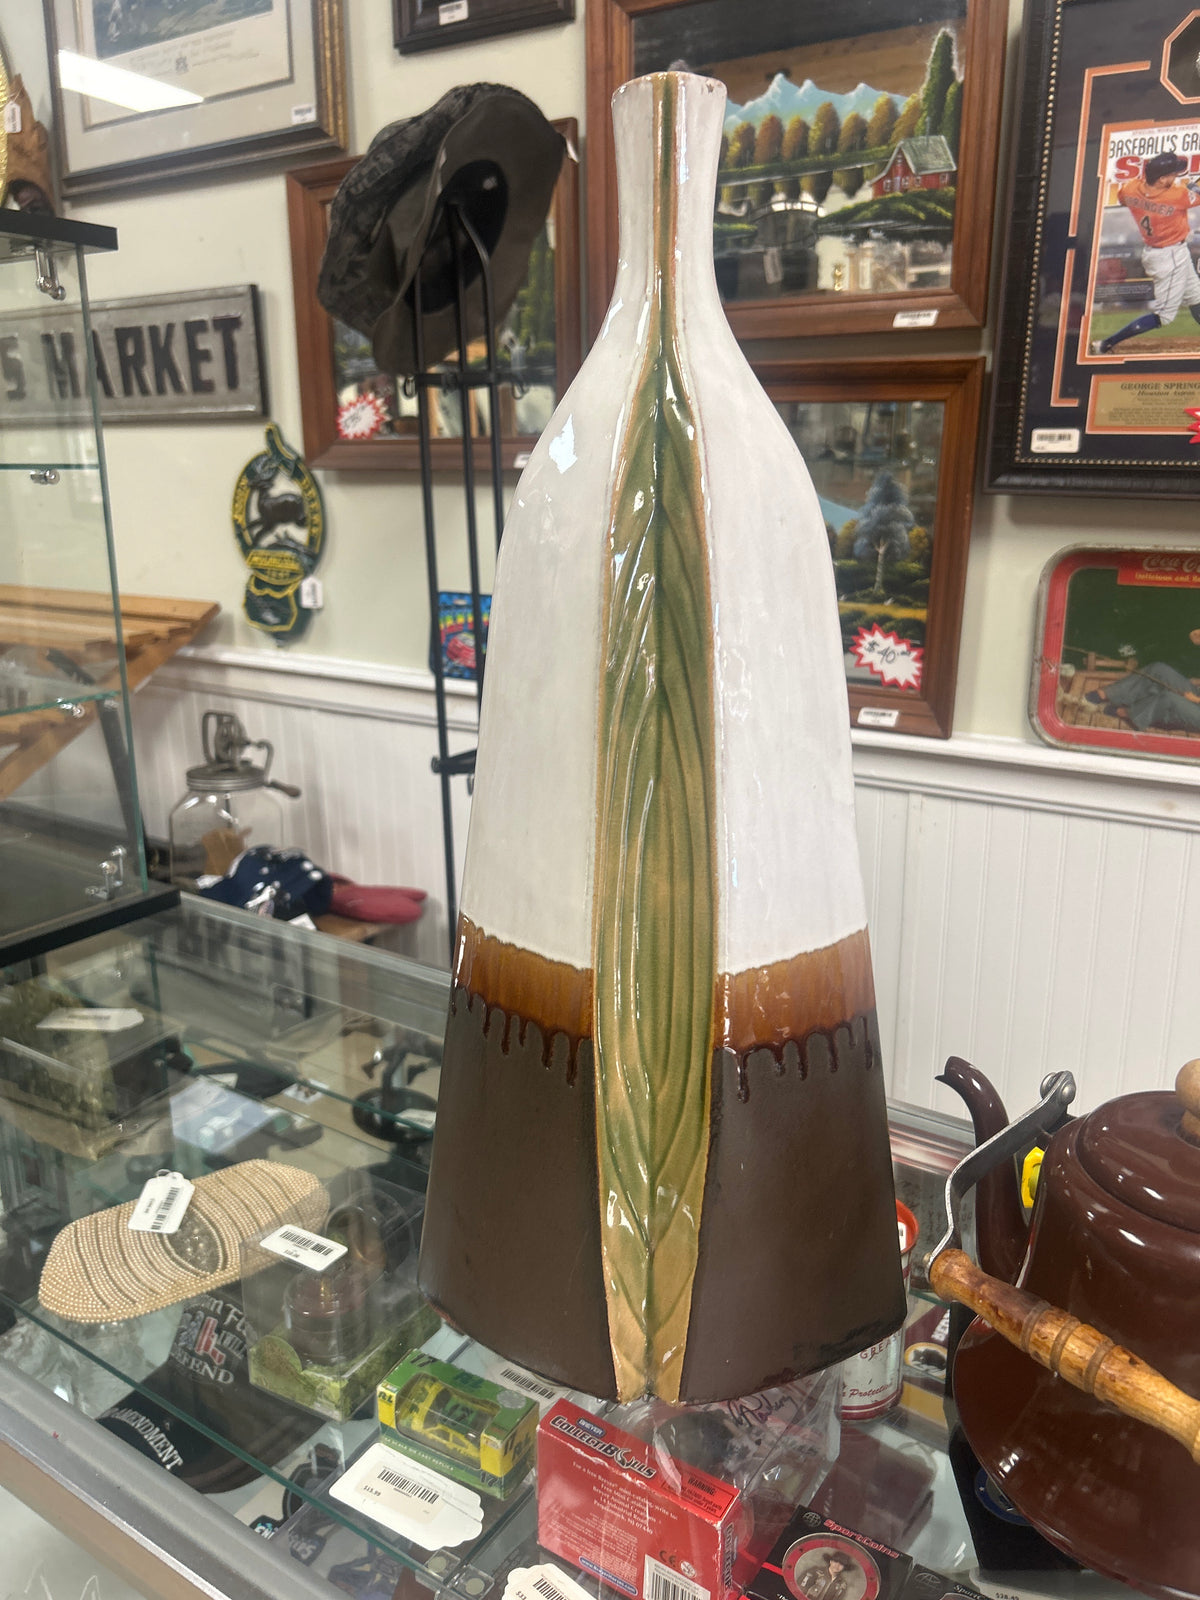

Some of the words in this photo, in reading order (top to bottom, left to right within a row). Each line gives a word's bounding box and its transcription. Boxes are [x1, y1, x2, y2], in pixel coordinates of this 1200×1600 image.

[1141, 215, 1153, 236] 4
[41, 314, 243, 400] MARKET
[1120, 382, 1160, 390] GEORGE
[1135, 572, 1172, 581] Delicious
[410, 1353, 438, 1368] 17
[432, 1458, 454, 1471] REPLICA
[480, 1471, 497, 1487] 17
